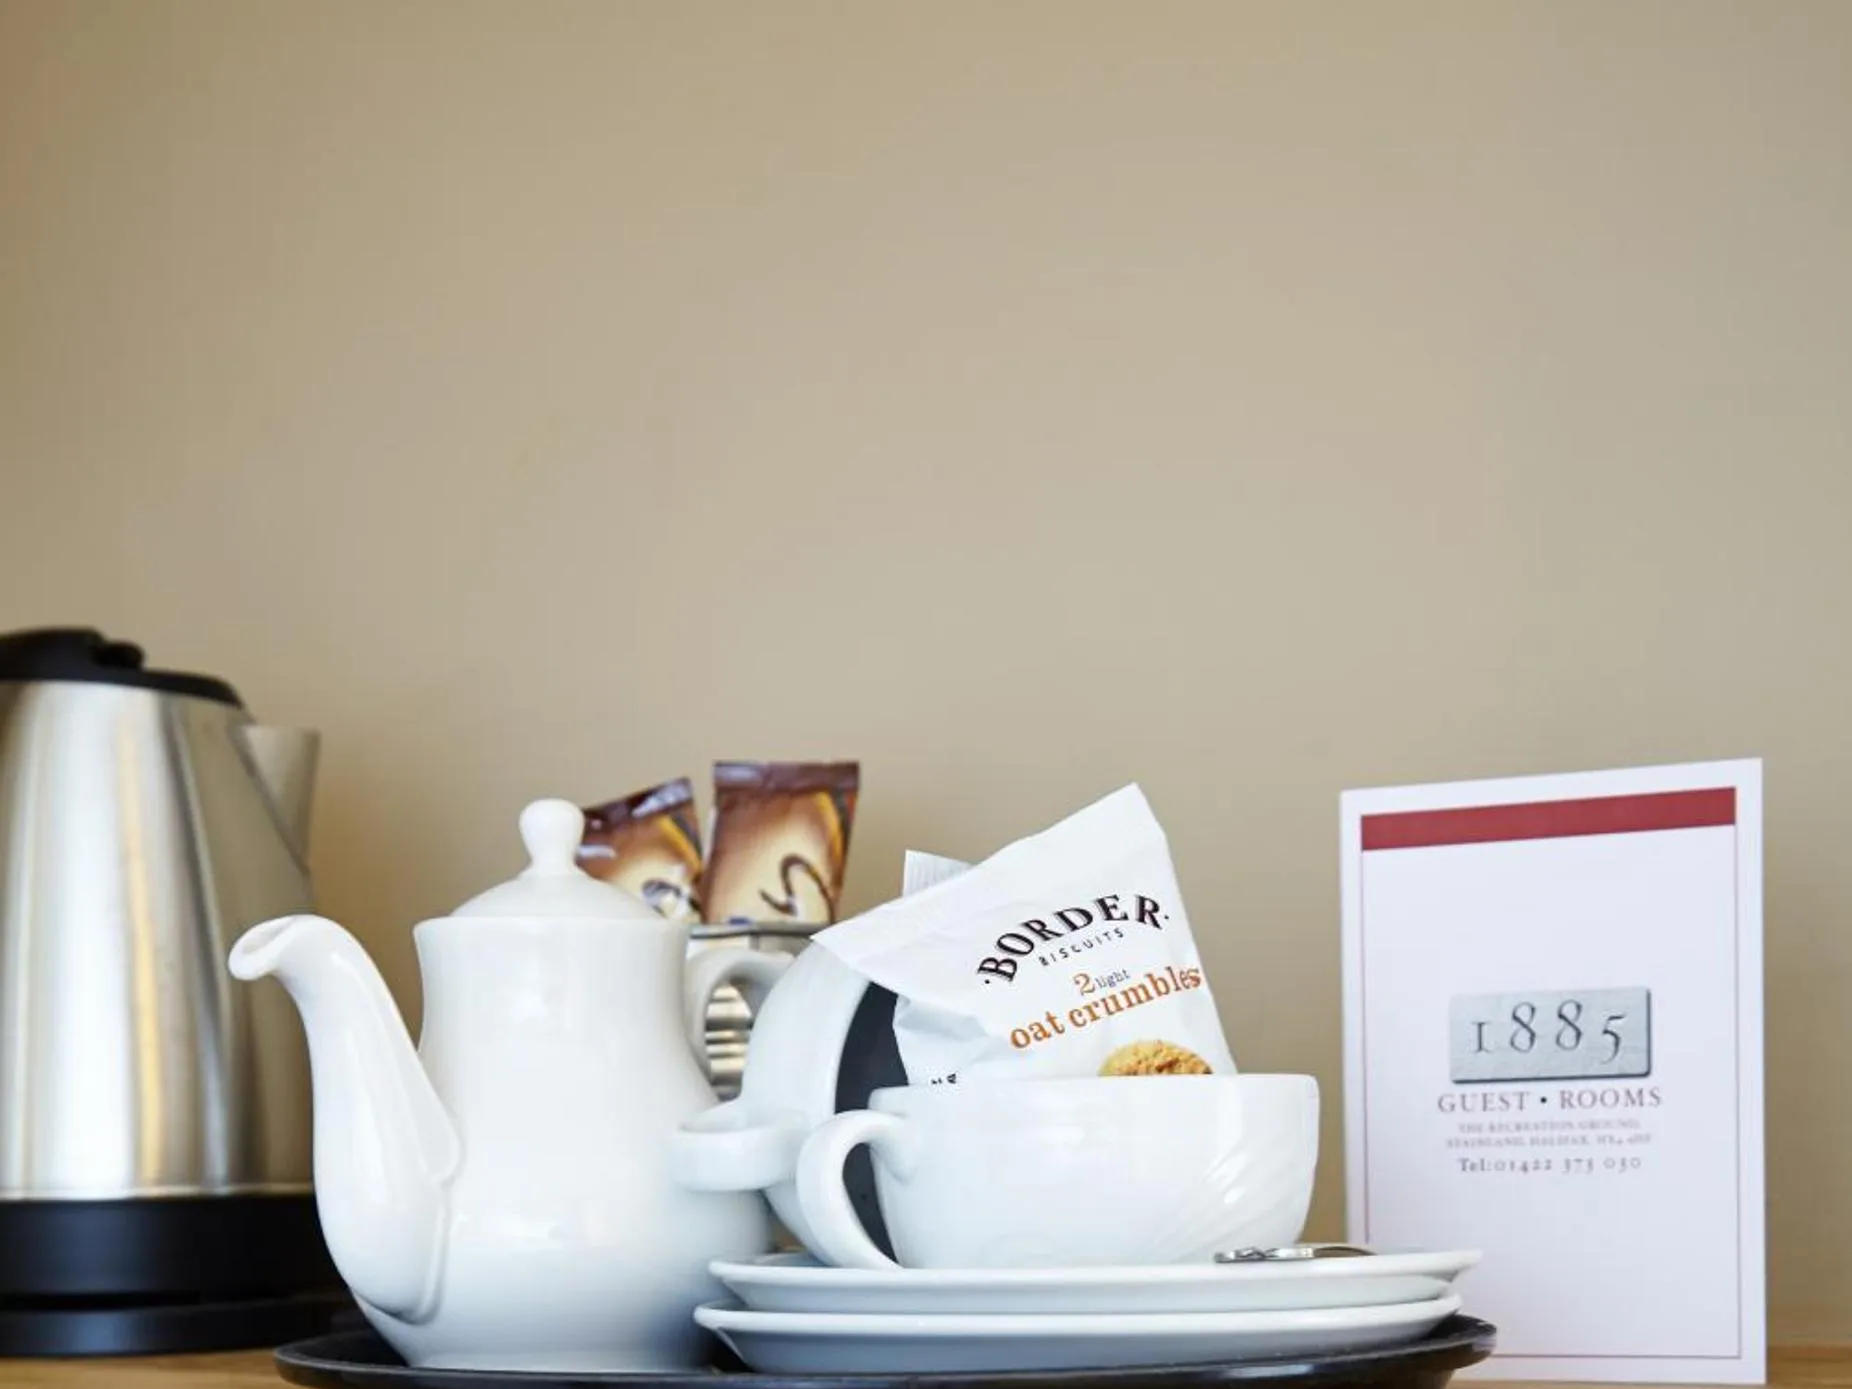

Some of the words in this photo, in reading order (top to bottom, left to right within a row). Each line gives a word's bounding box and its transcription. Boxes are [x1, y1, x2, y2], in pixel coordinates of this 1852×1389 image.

[977, 894, 1163, 982] BORDER
[1038, 927, 1124, 966] BISCUITS
[1072, 973, 1096, 996] 2
[1095, 969, 1131, 988] light
[1010, 1011, 1066, 1049] oat
[1068, 965, 1202, 1029] crumbles
[1473, 1000, 1627, 1064] 1885
[1437, 1091, 1530, 1113] GUEST
[1558, 1086, 1663, 1108] ROOMS
[1563, 1158, 1594, 1175] 373
[1602, 1156, 1642, 1174] 030
